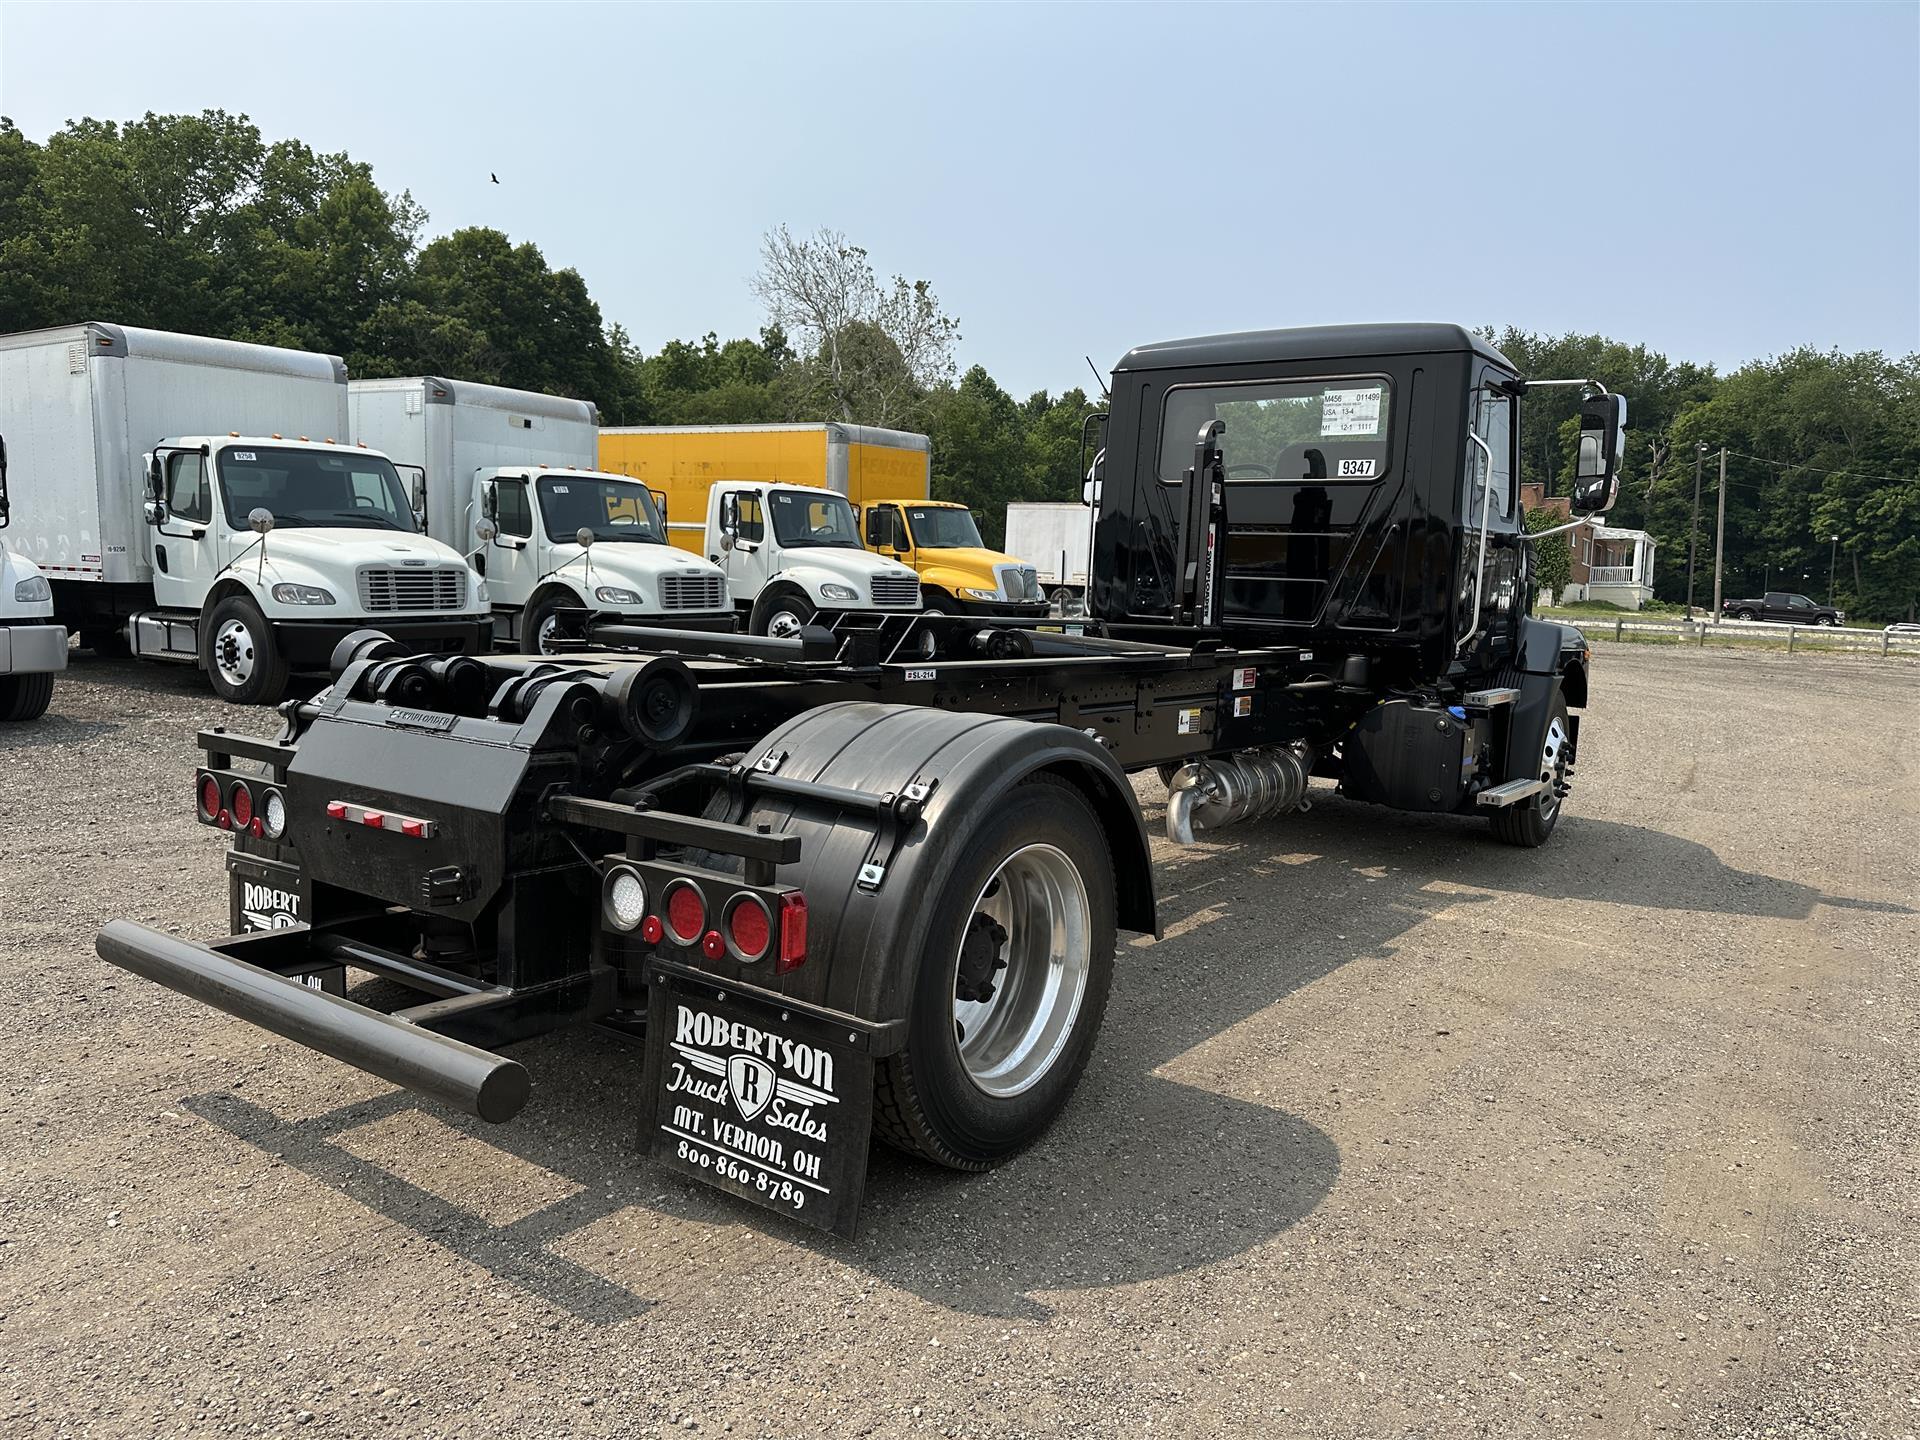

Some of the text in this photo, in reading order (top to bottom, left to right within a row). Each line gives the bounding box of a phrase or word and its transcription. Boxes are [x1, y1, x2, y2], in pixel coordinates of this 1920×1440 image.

[1324, 393, 1380, 403] M456 011499
[1342, 460, 1372, 475] 9347
[244, 881, 300, 915] ROBERT
[675, 1005, 834, 1093] ROBERTSON
[666, 1062, 828, 1143] Truck Sales
[740, 1061, 760, 1106] R
[672, 1104, 822, 1180] MT. VERNON, OH
[677, 1140, 806, 1210] 800-860-8789
